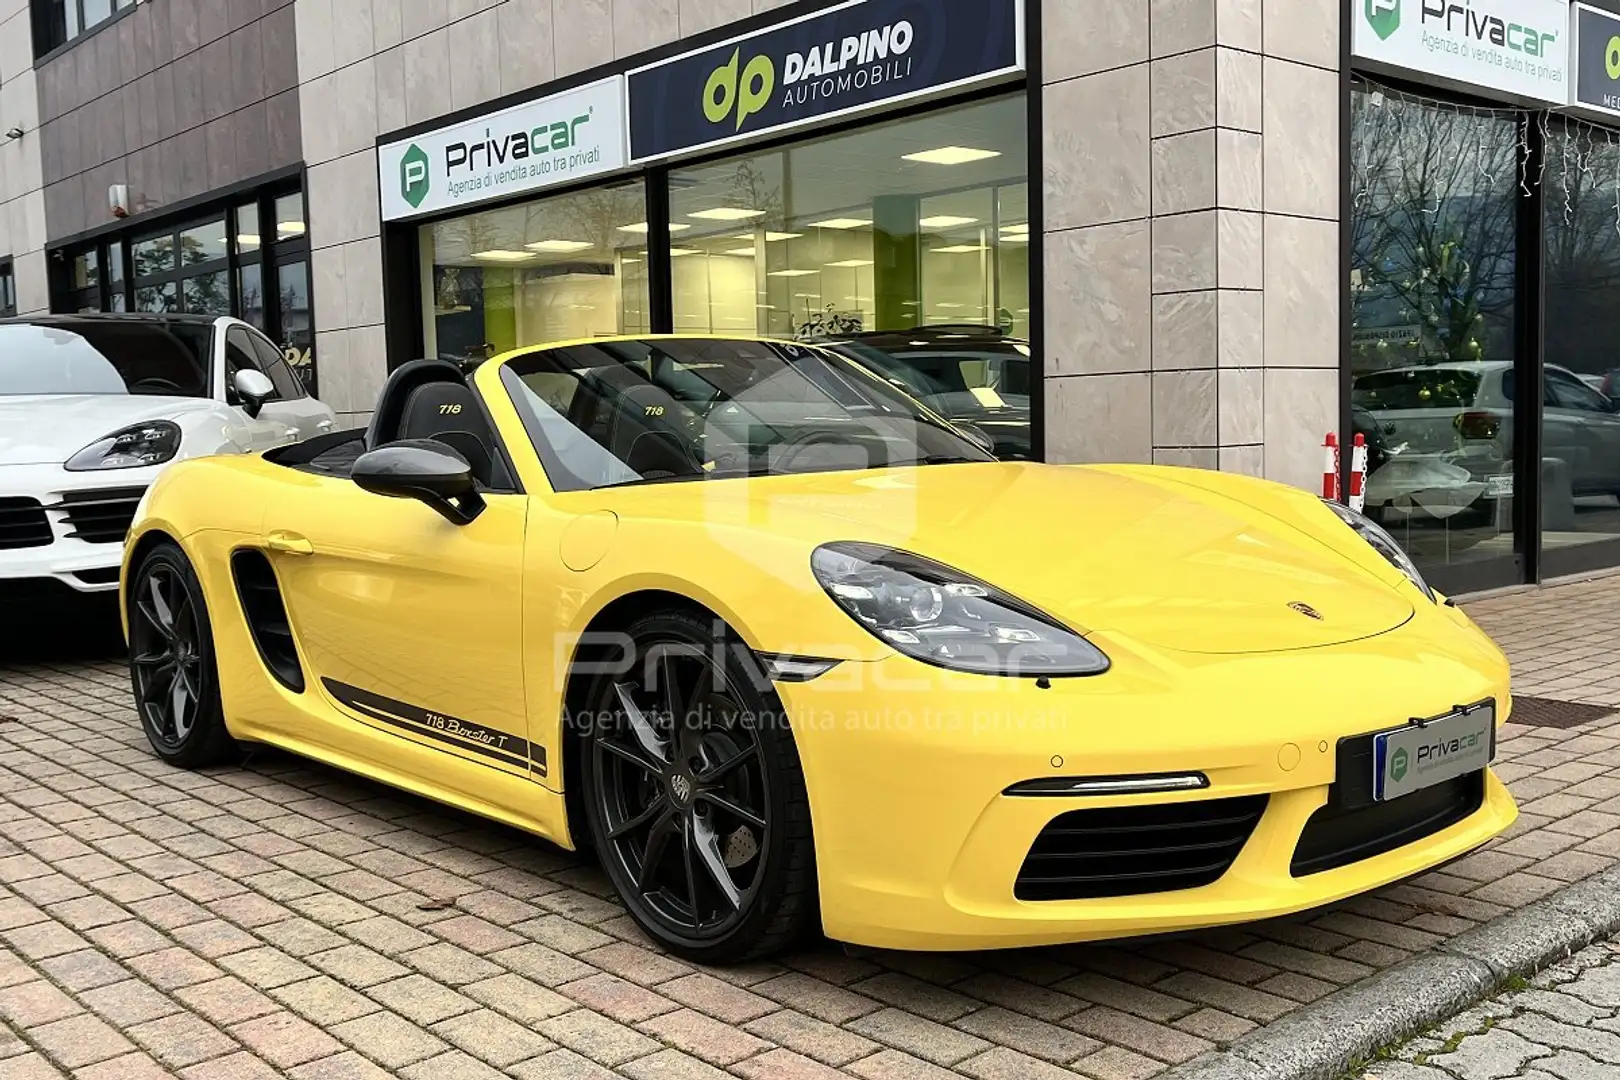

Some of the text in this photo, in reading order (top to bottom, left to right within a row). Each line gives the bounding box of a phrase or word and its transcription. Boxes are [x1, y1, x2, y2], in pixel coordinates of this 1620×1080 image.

[783, 20, 914, 85] DALPINO
[1421, 0, 1556, 58] Privacar
[1421, 30, 1562, 82] Agenzia di vendita auto tra privati
[782, 57, 912, 108] AUTOMOBILI
[445, 114, 590, 178] Privacar
[447, 145, 600, 198] Agenzia di vendita auto tra privati
[439, 403, 462, 414] 718
[645, 406, 665, 416] 718
[426, 713, 508, 747] 718 Boxster T
[1417, 732, 1486, 764] Privacar
